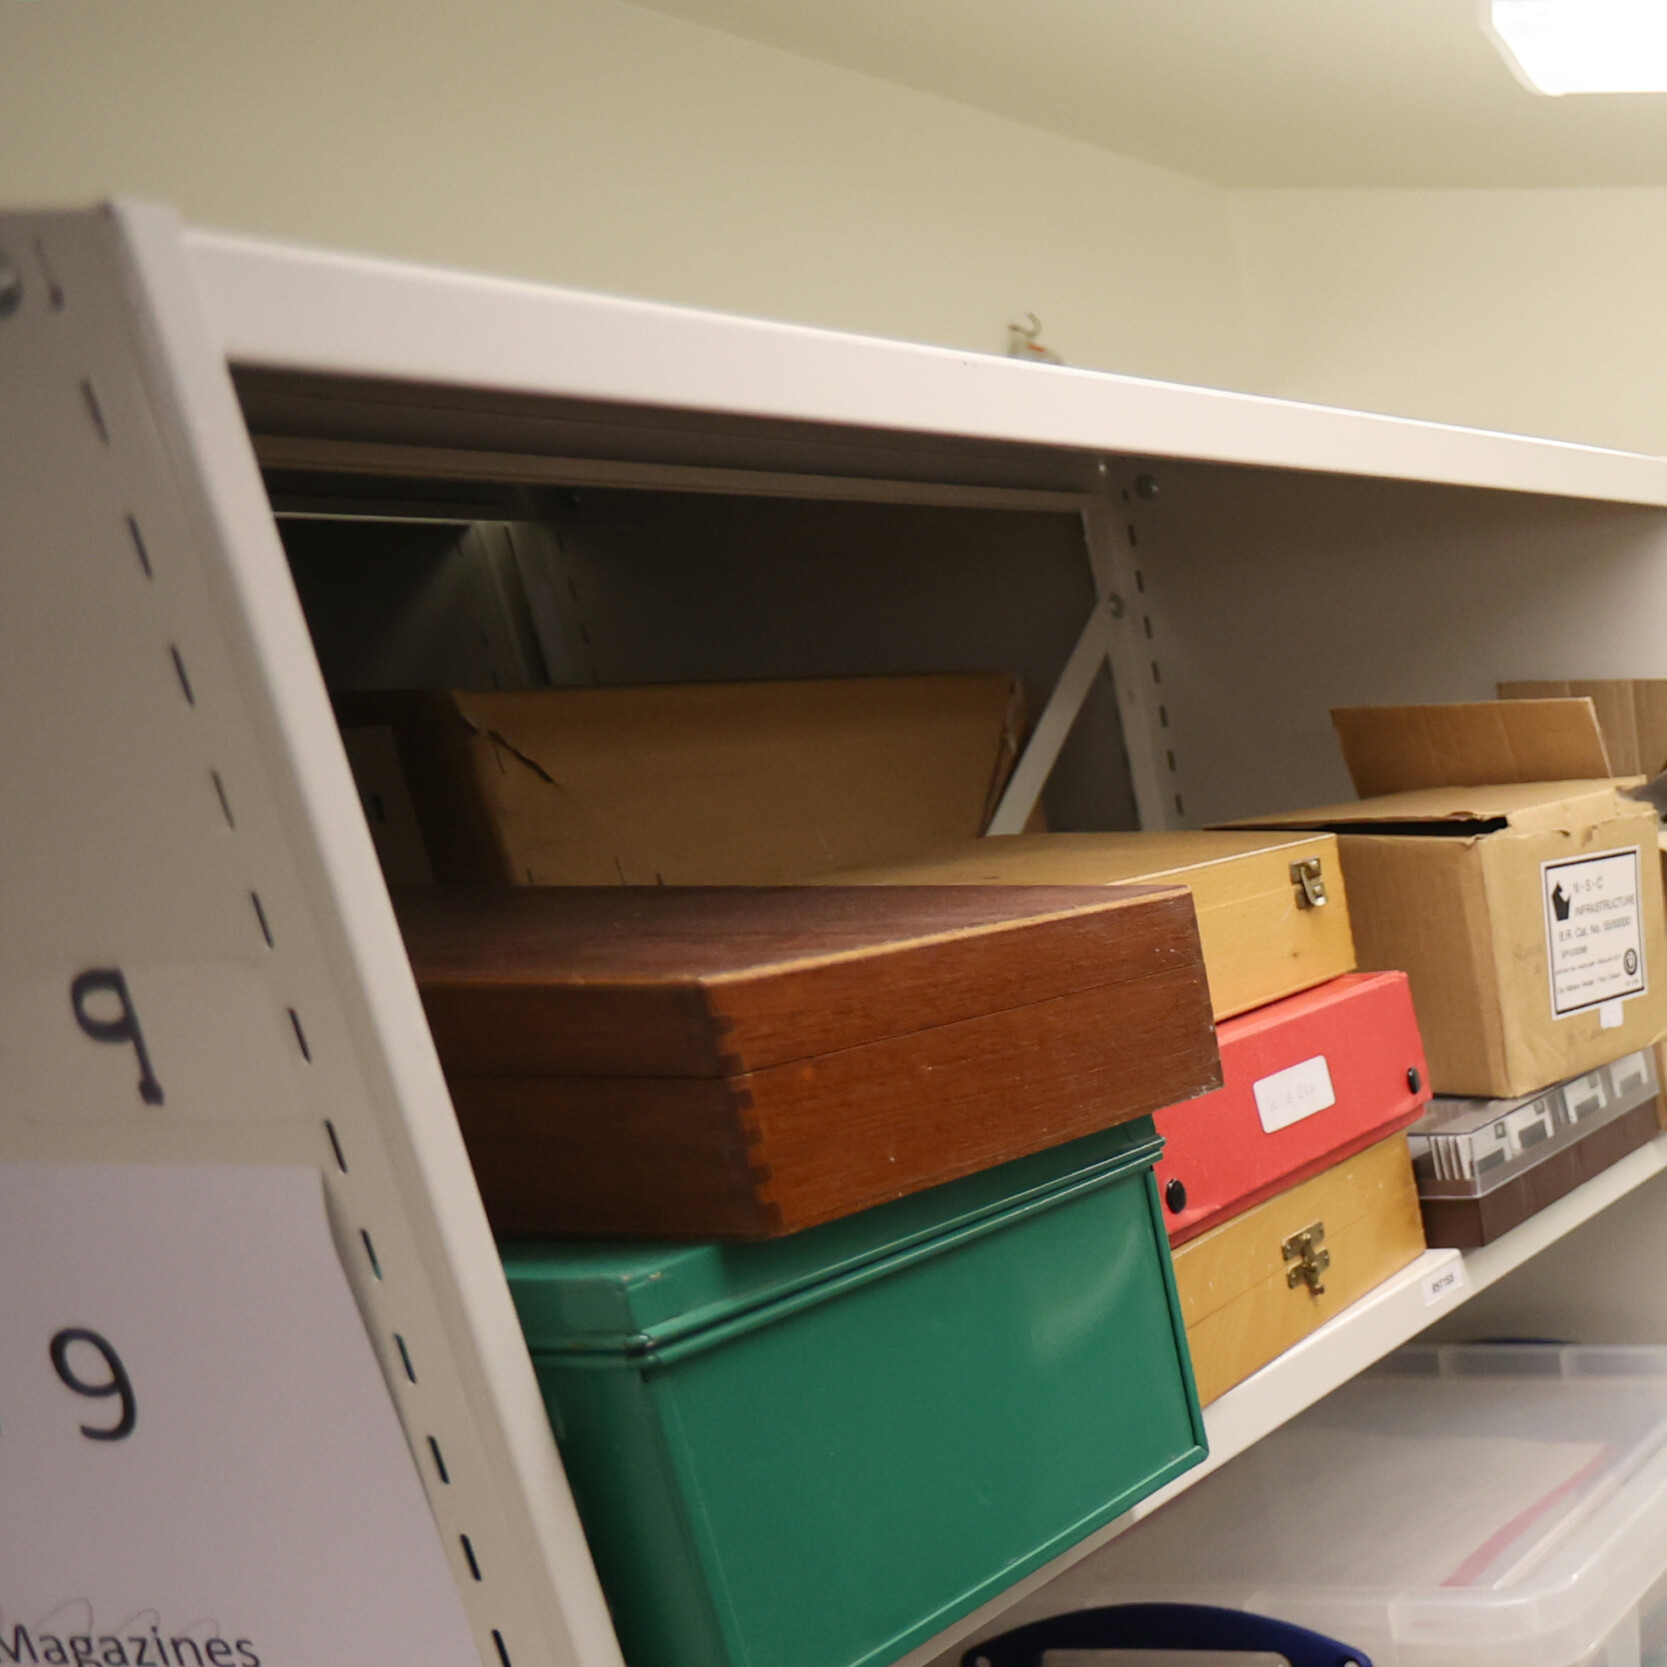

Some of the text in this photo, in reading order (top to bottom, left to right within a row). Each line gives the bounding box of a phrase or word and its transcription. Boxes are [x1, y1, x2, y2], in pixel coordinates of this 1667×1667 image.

[1574, 893, 1636, 916] INFRASTRUCTURE
[70, 967, 164, 1106] 9
[49, 1328, 137, 1442] 9
